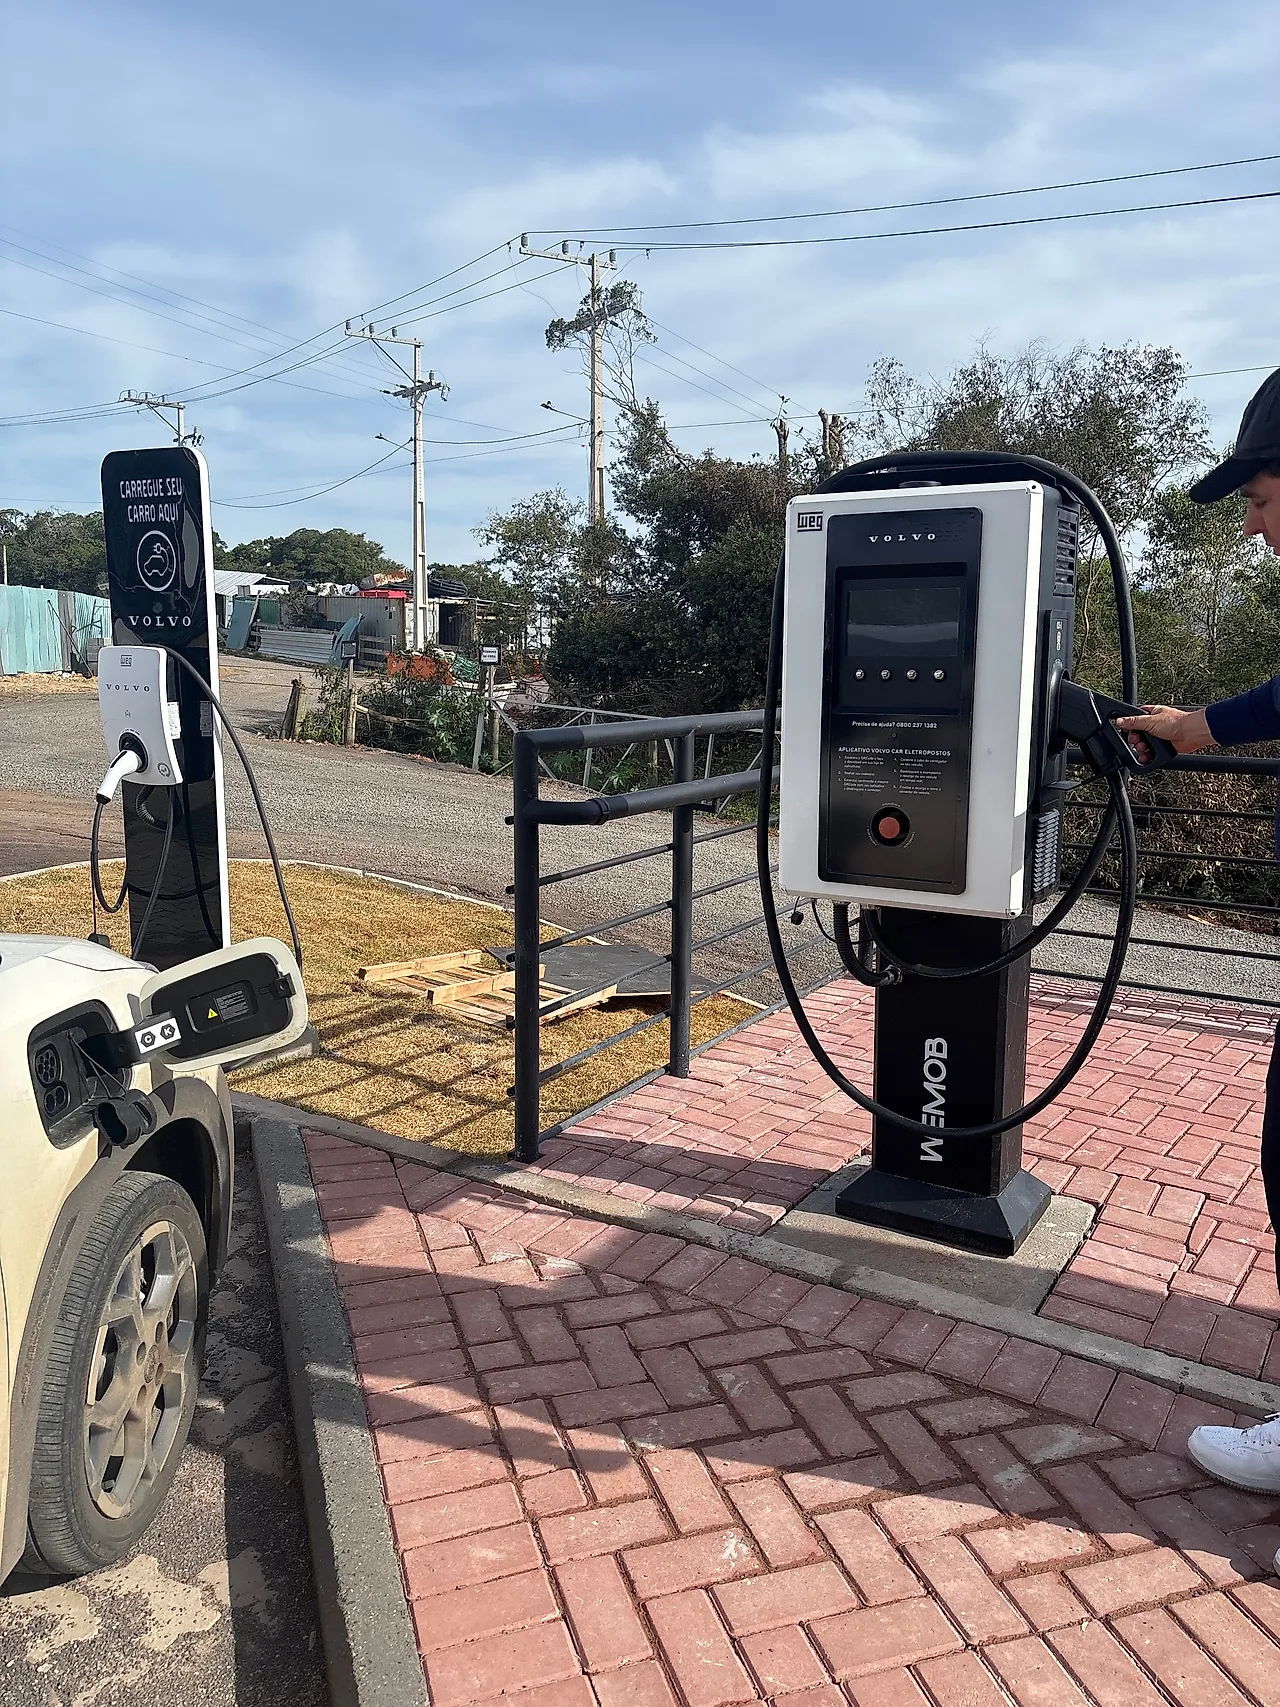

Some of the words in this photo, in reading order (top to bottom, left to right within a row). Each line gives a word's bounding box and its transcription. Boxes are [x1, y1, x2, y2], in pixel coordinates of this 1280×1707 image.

[119, 479, 165, 498] CARREGUE
[166, 477, 182, 496] SEU
[127, 503, 156, 523] CARRO
[158, 503, 179, 523] AQUI
[868, 533, 937, 543] VOLVO
[128, 615, 192, 627] VOLVO
[106, 683, 151, 692] VOLVO
[904, 748, 951, 757] ELETROPOSTOS
